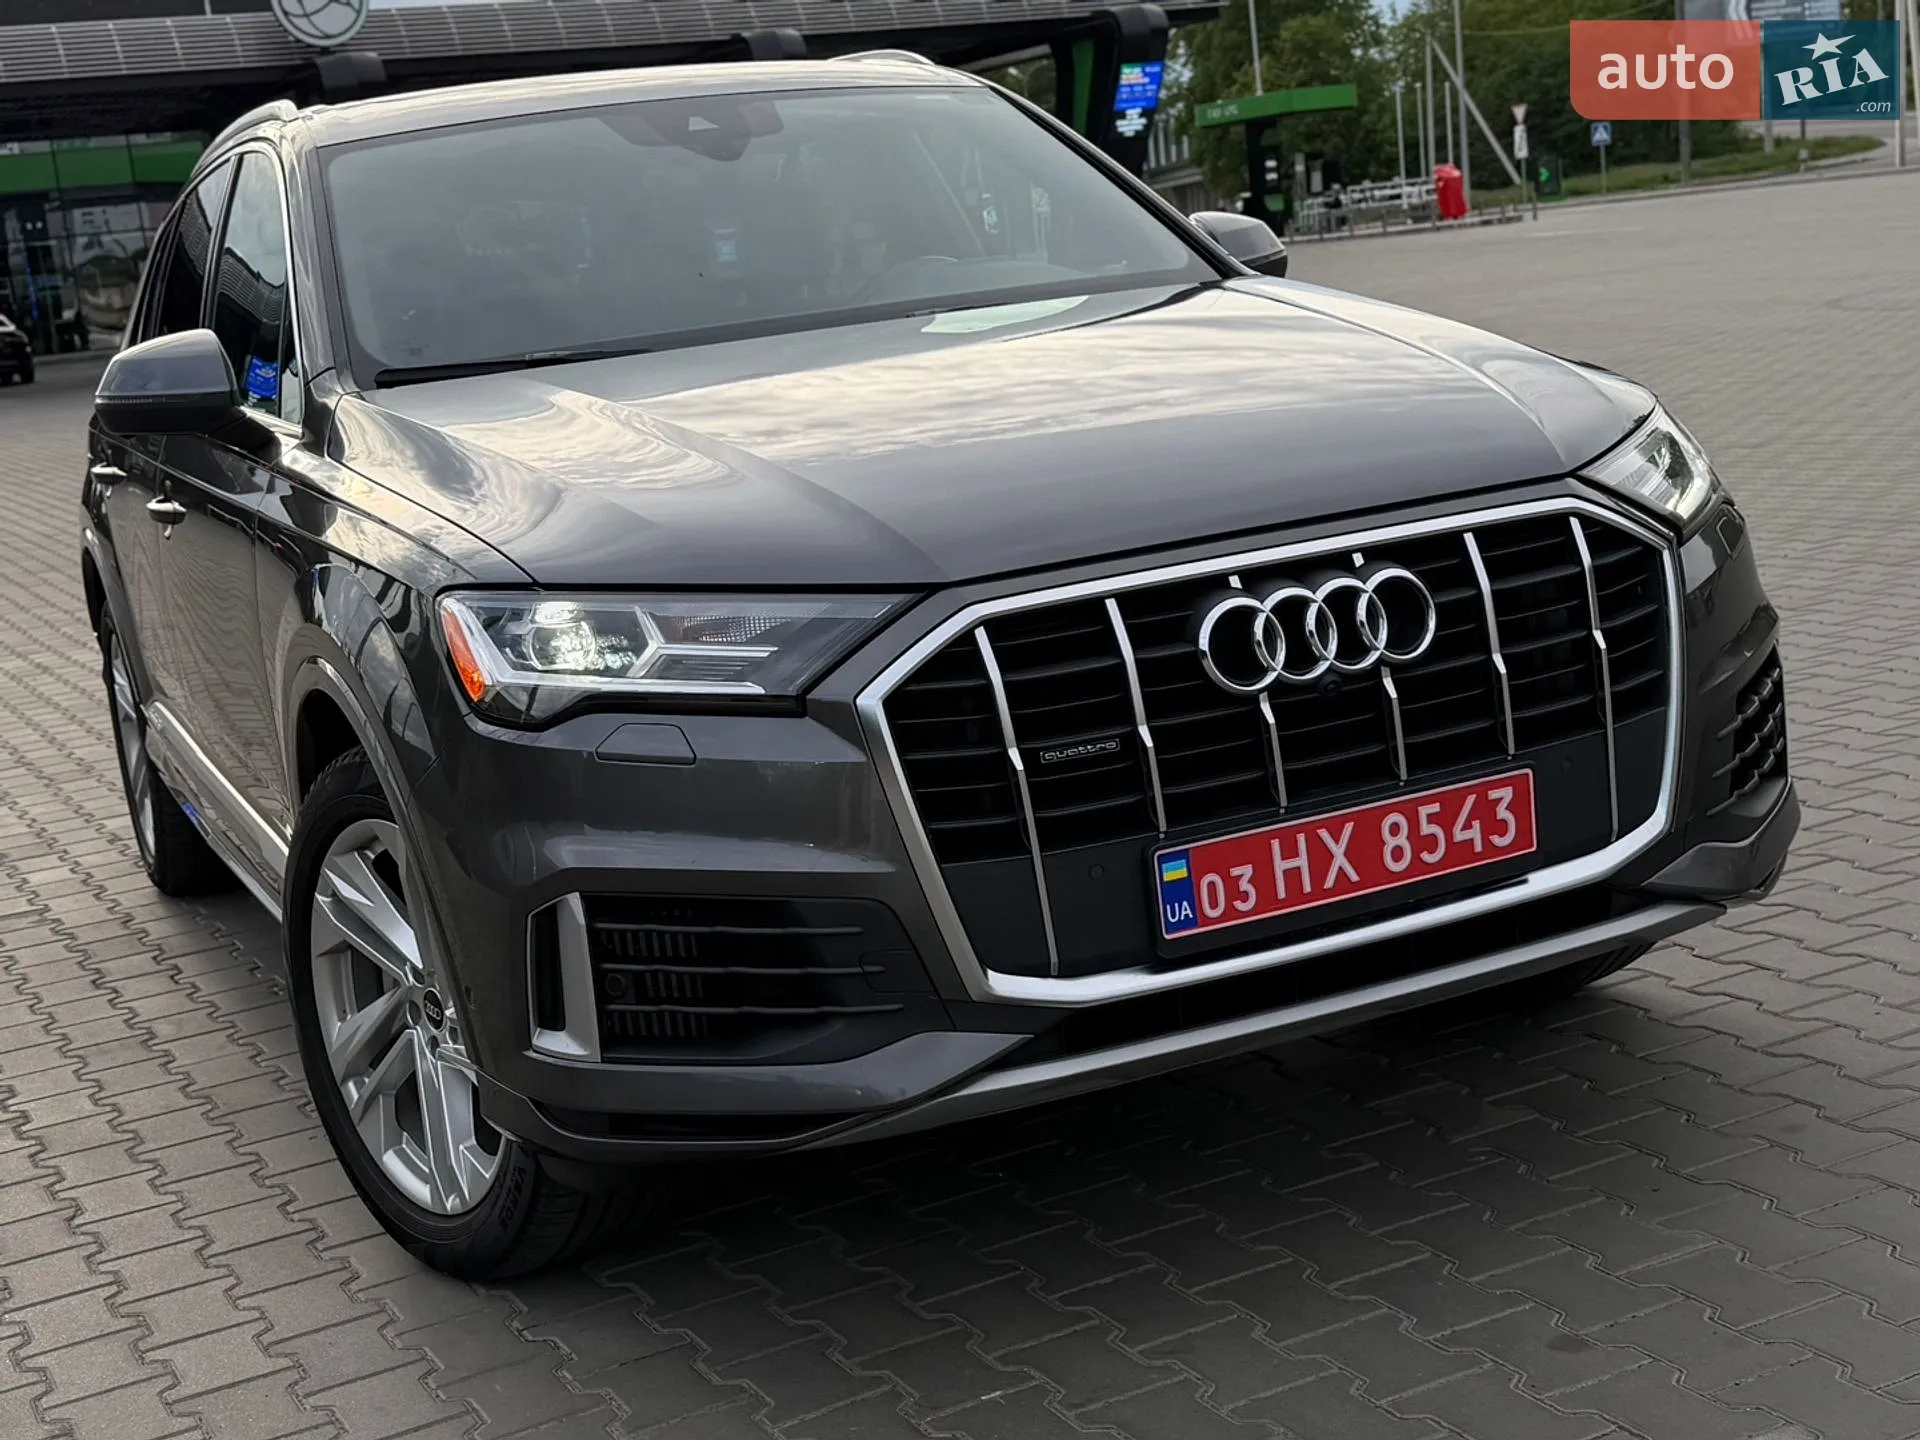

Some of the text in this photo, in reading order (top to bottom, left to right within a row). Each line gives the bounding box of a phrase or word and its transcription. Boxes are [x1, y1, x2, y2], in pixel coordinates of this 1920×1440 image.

[1044, 741, 1117, 760] quattro
[1200, 786, 1517, 919] 03 HX 8543
[1166, 901, 1194, 923] UA
